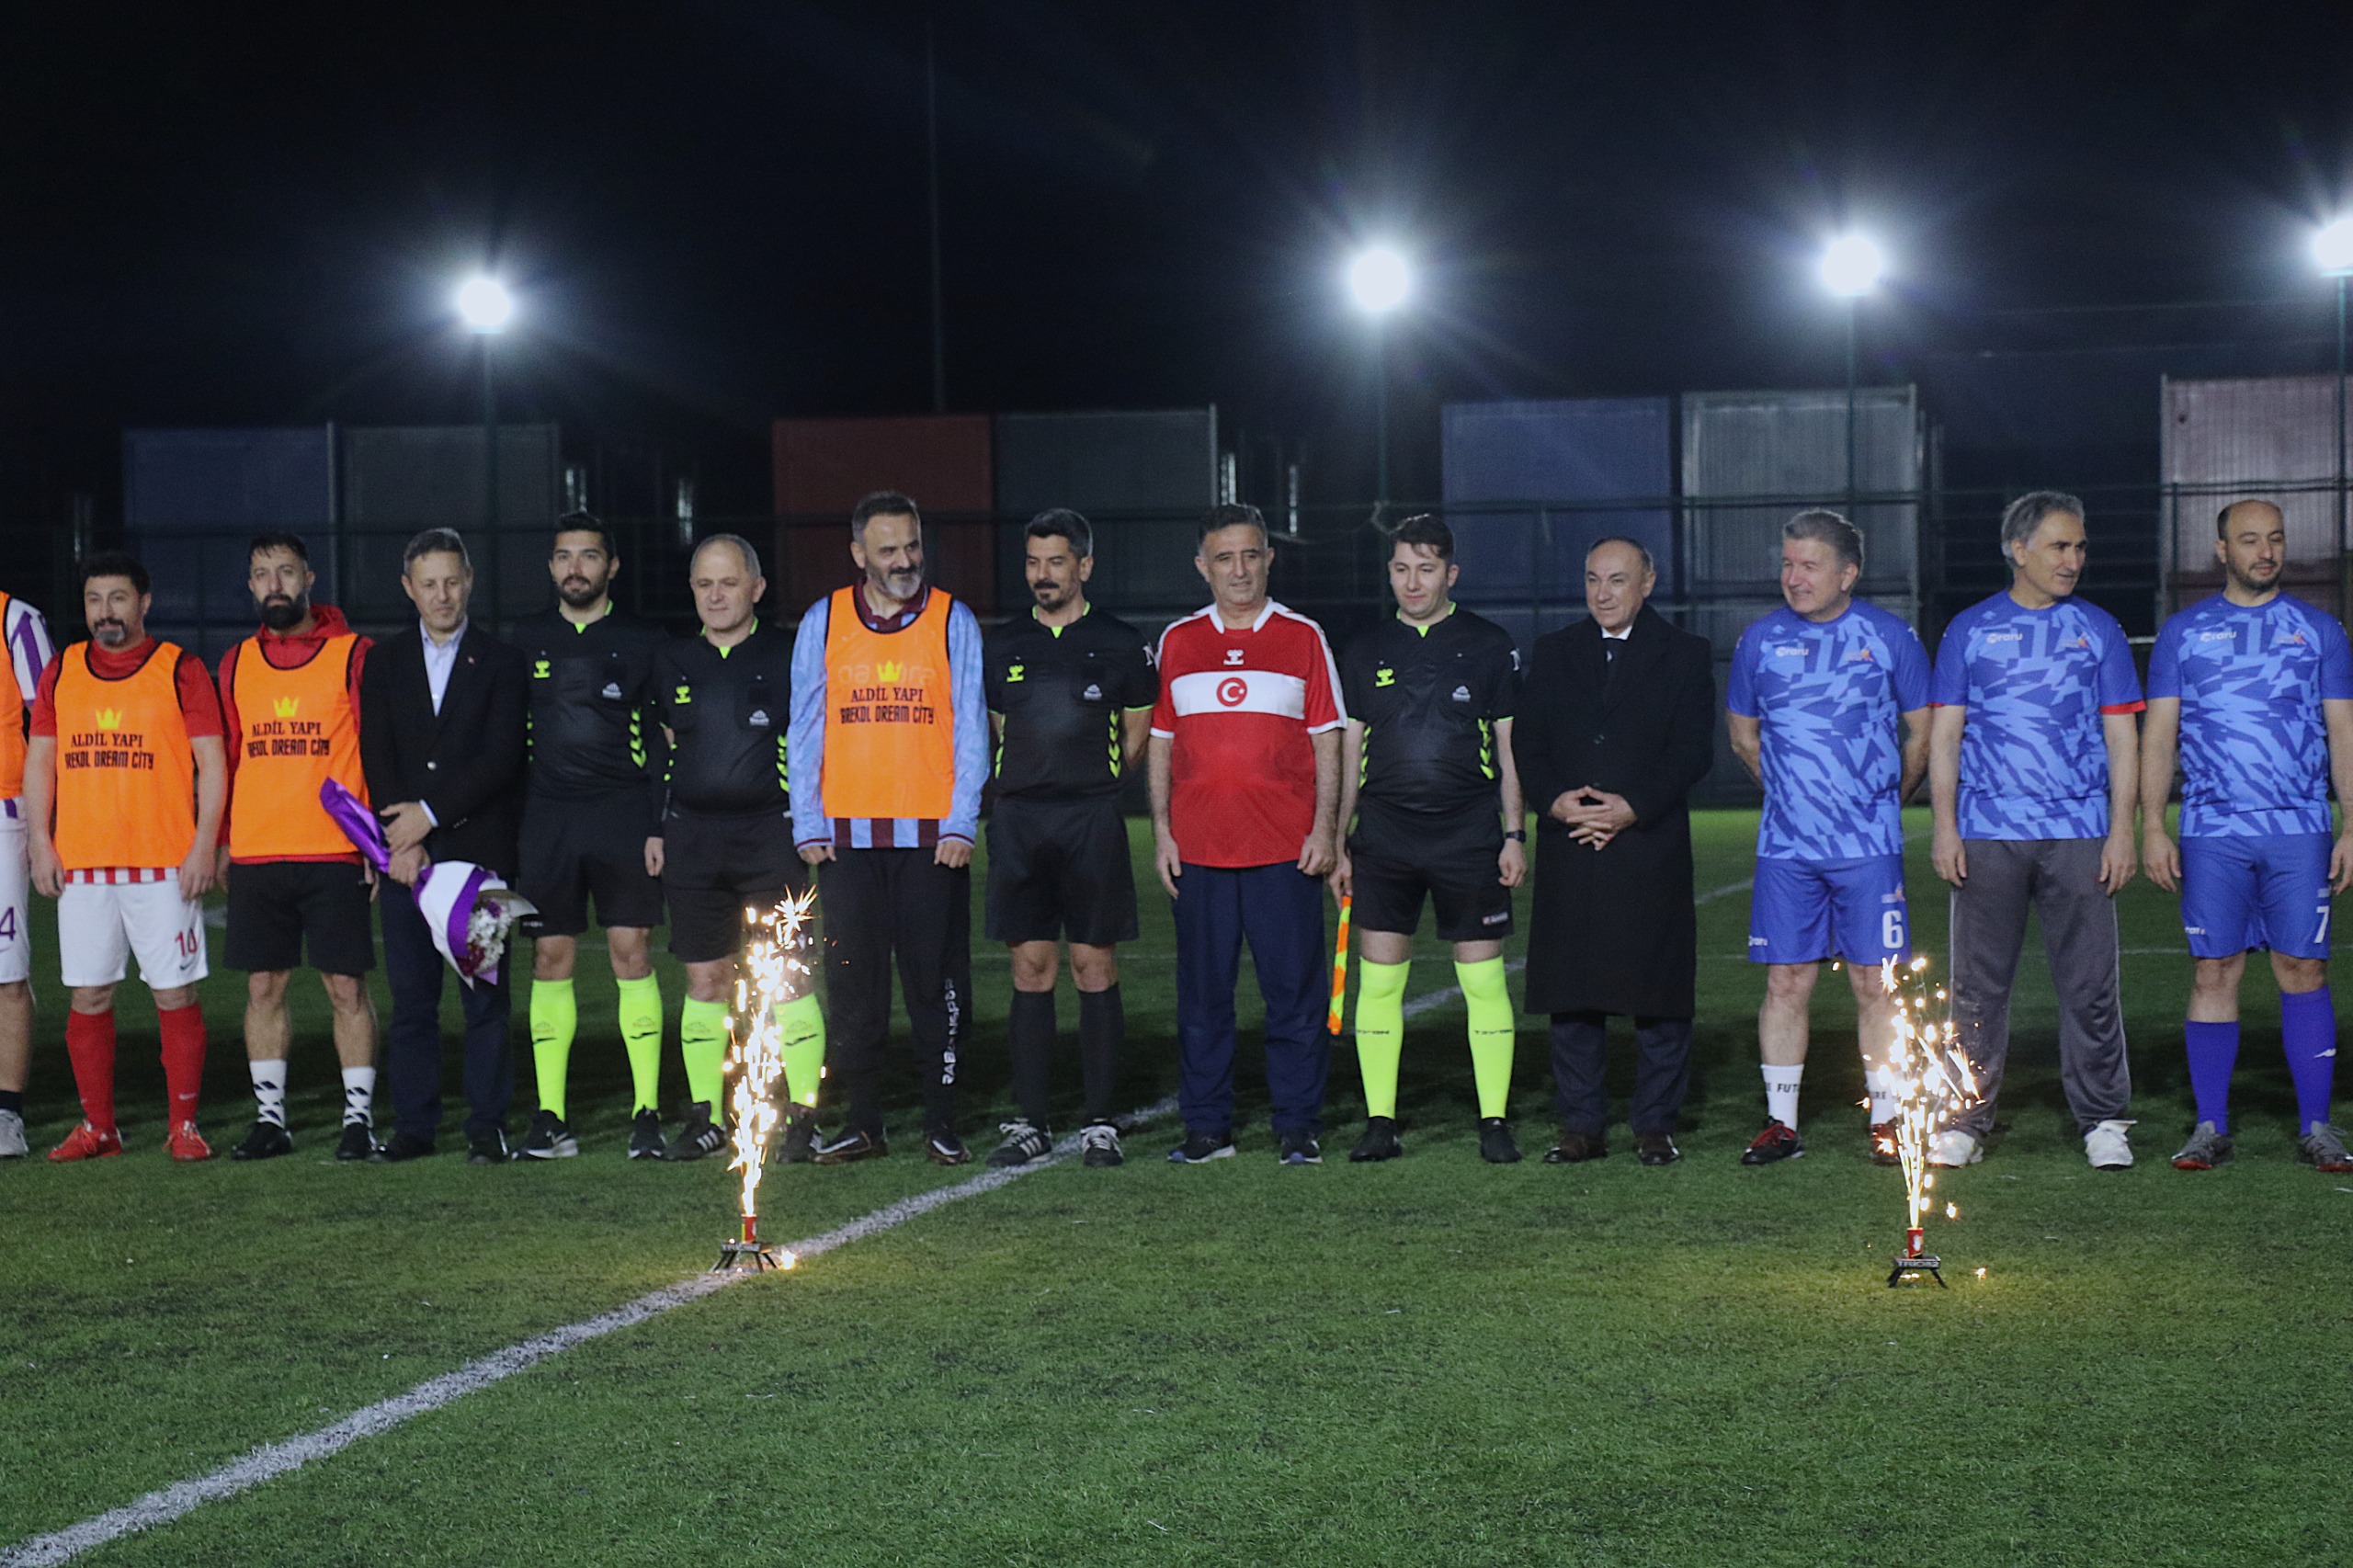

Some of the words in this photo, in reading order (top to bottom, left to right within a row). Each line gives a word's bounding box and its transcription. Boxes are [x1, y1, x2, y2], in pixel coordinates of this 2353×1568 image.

[893, 687, 924, 702] YAPI
[290, 722, 321, 736] YAPI
[112, 733, 142, 748] YAPI
[1882, 910, 1904, 949] 6
[2314, 905, 2330, 943] 7
[175, 927, 198, 957] 10
